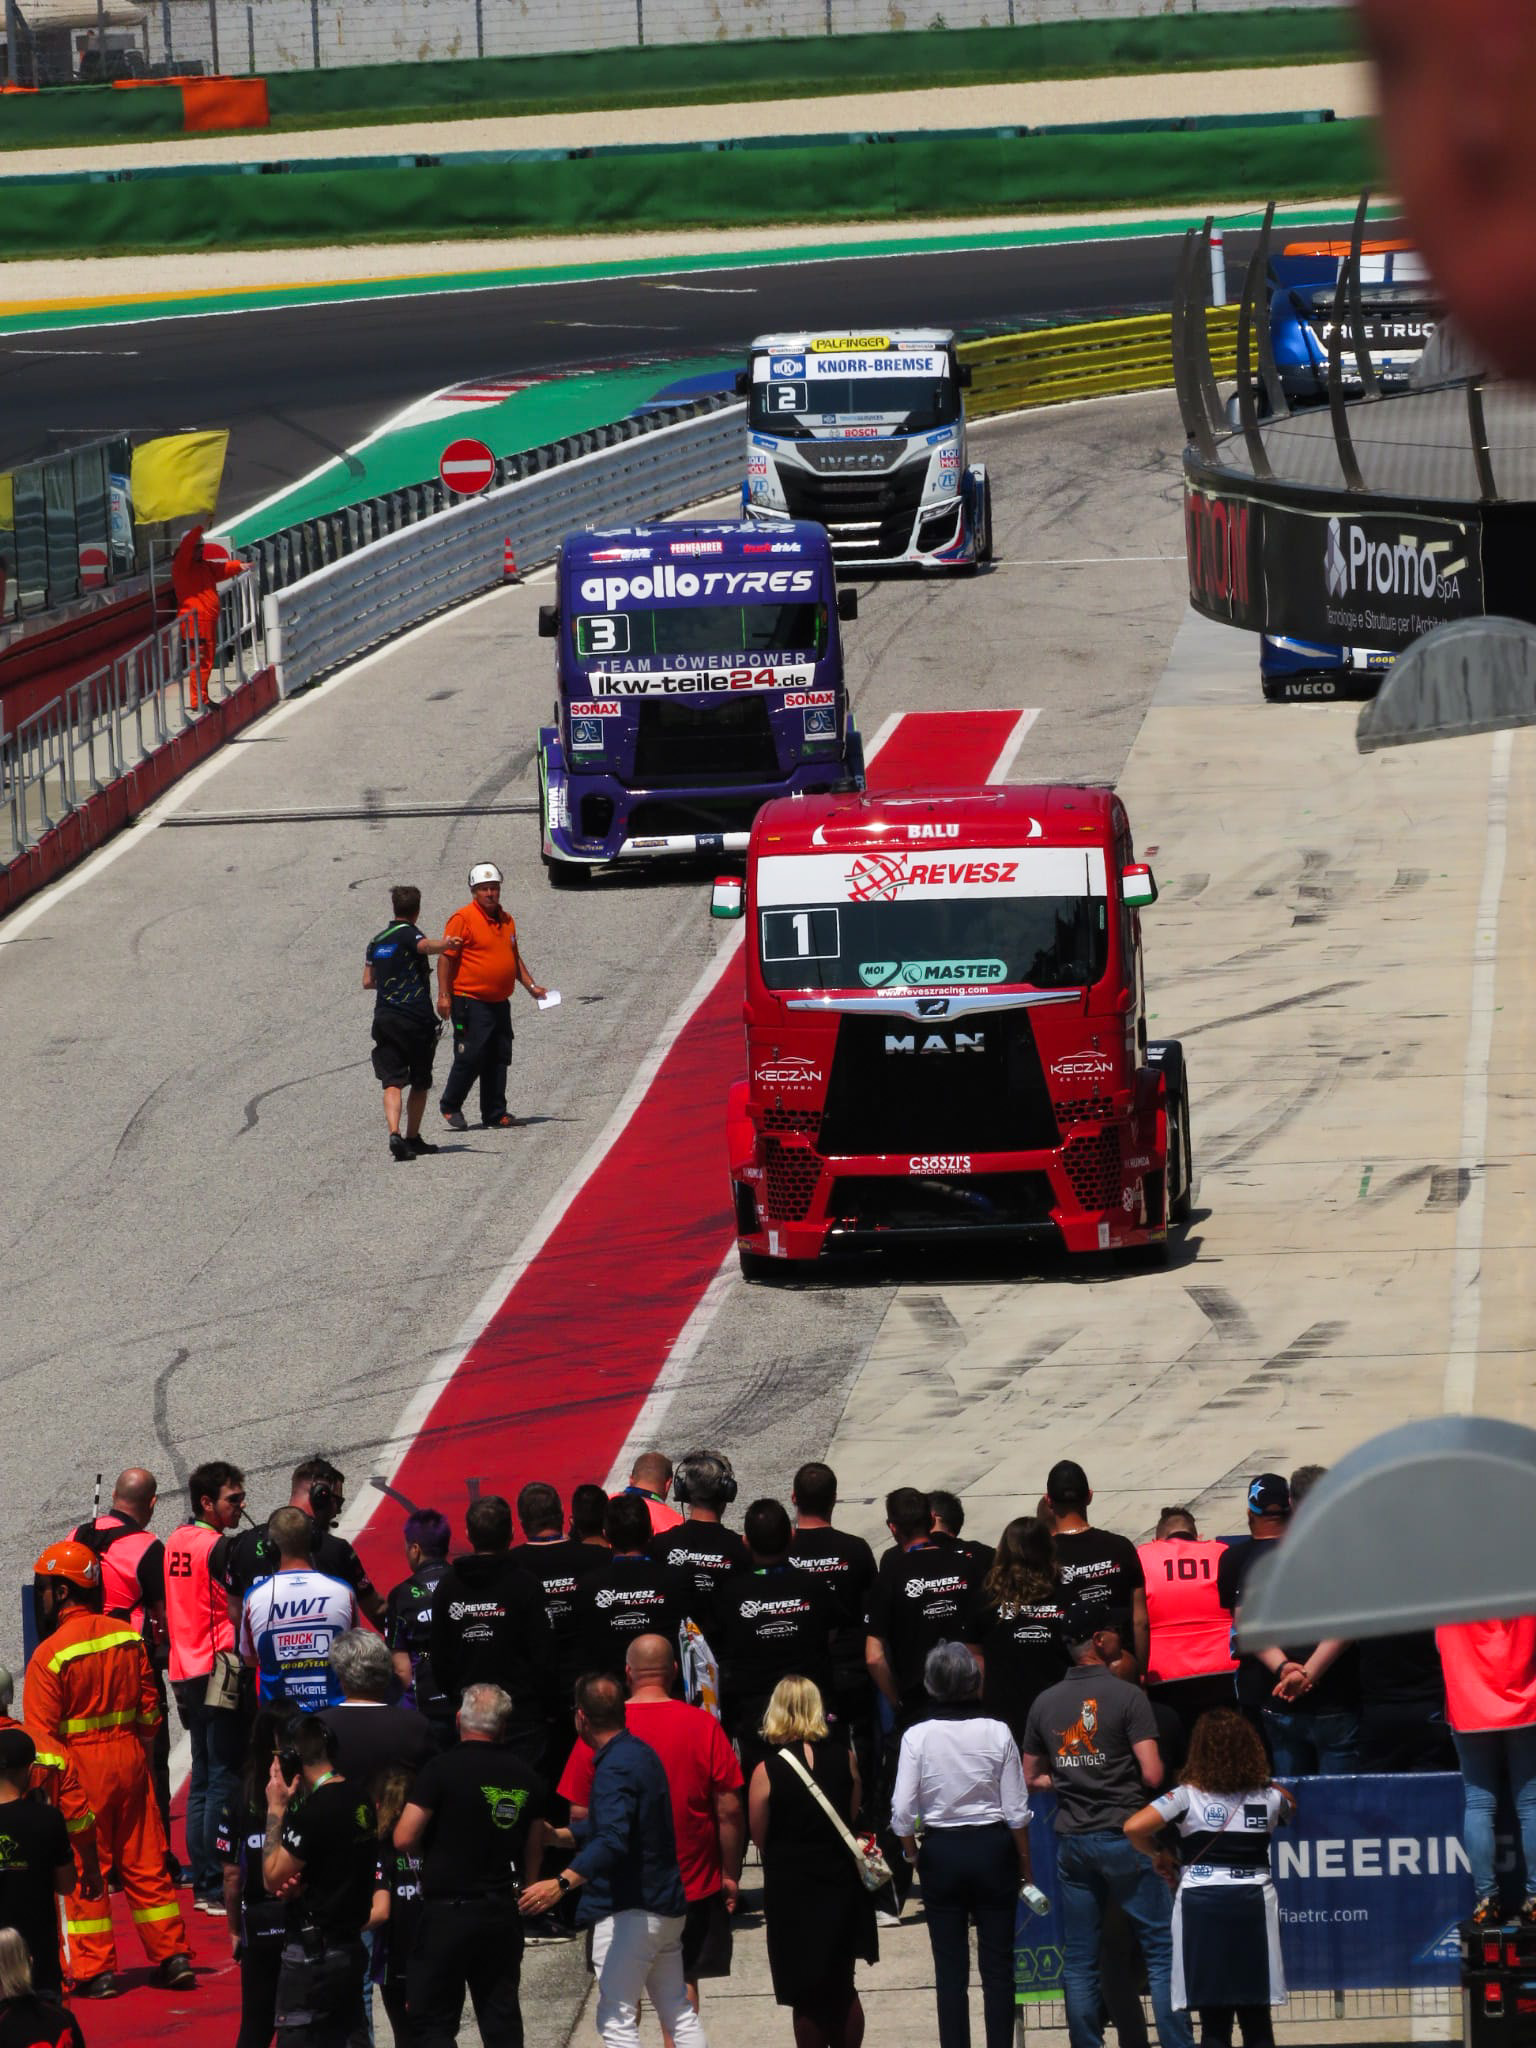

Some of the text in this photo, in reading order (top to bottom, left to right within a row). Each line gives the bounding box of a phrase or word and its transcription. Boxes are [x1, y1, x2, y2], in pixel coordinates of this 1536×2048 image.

[1381, 322, 1436, 338] TRUC
[816, 337, 885, 350] PALFINGER
[817, 358, 934, 373] KNORR-BREMSE
[778, 387, 796, 410] 2
[845, 428, 878, 437] BOSCH
[820, 454, 885, 470] IVECO
[1350, 525, 1436, 598] Promo
[581, 565, 814, 611] apollo TYRES
[1436, 575, 1461, 603] SpA
[591, 619, 616, 650] 3
[598, 652, 807, 674] TEAM LÖWENPOWER
[599, 668, 807, 696] lkw-teile24.de
[1285, 683, 1335, 696] IVECO
[786, 693, 833, 706] SONAX
[571, 703, 619, 715] SONAX
[908, 823, 960, 838] BALU
[793, 914, 809, 955] 1
[924, 965, 1001, 980] MASTER
[877, 985, 989, 998] www.reveszracing.com
[885, 1033, 985, 1055] MAN
[168, 1552, 192, 1577] 23
[800, 1557, 840, 1568] REVESZ
[809, 1565, 849, 1573] RACING
[1075, 1560, 1112, 1575] REVESZ
[1085, 1567, 1121, 1580] RACING
[1164, 1558, 1210, 1582] 101
[543, 1577, 575, 1588] EVESZ
[924, 1576, 960, 1588] REVESZ
[933, 1583, 968, 1593] RACING
[545, 1585, 577, 1594] RACIN
[615, 1590, 655, 1600] REVESZ
[269, 1596, 331, 1621] NWT
[464, 1602, 498, 1612] REVESZ
[624, 1598, 665, 1606] RACING
[760, 1599, 801, 1611] REVESZ
[770, 1605, 810, 1615] RACING
[277, 1633, 313, 1646] TRUCK
